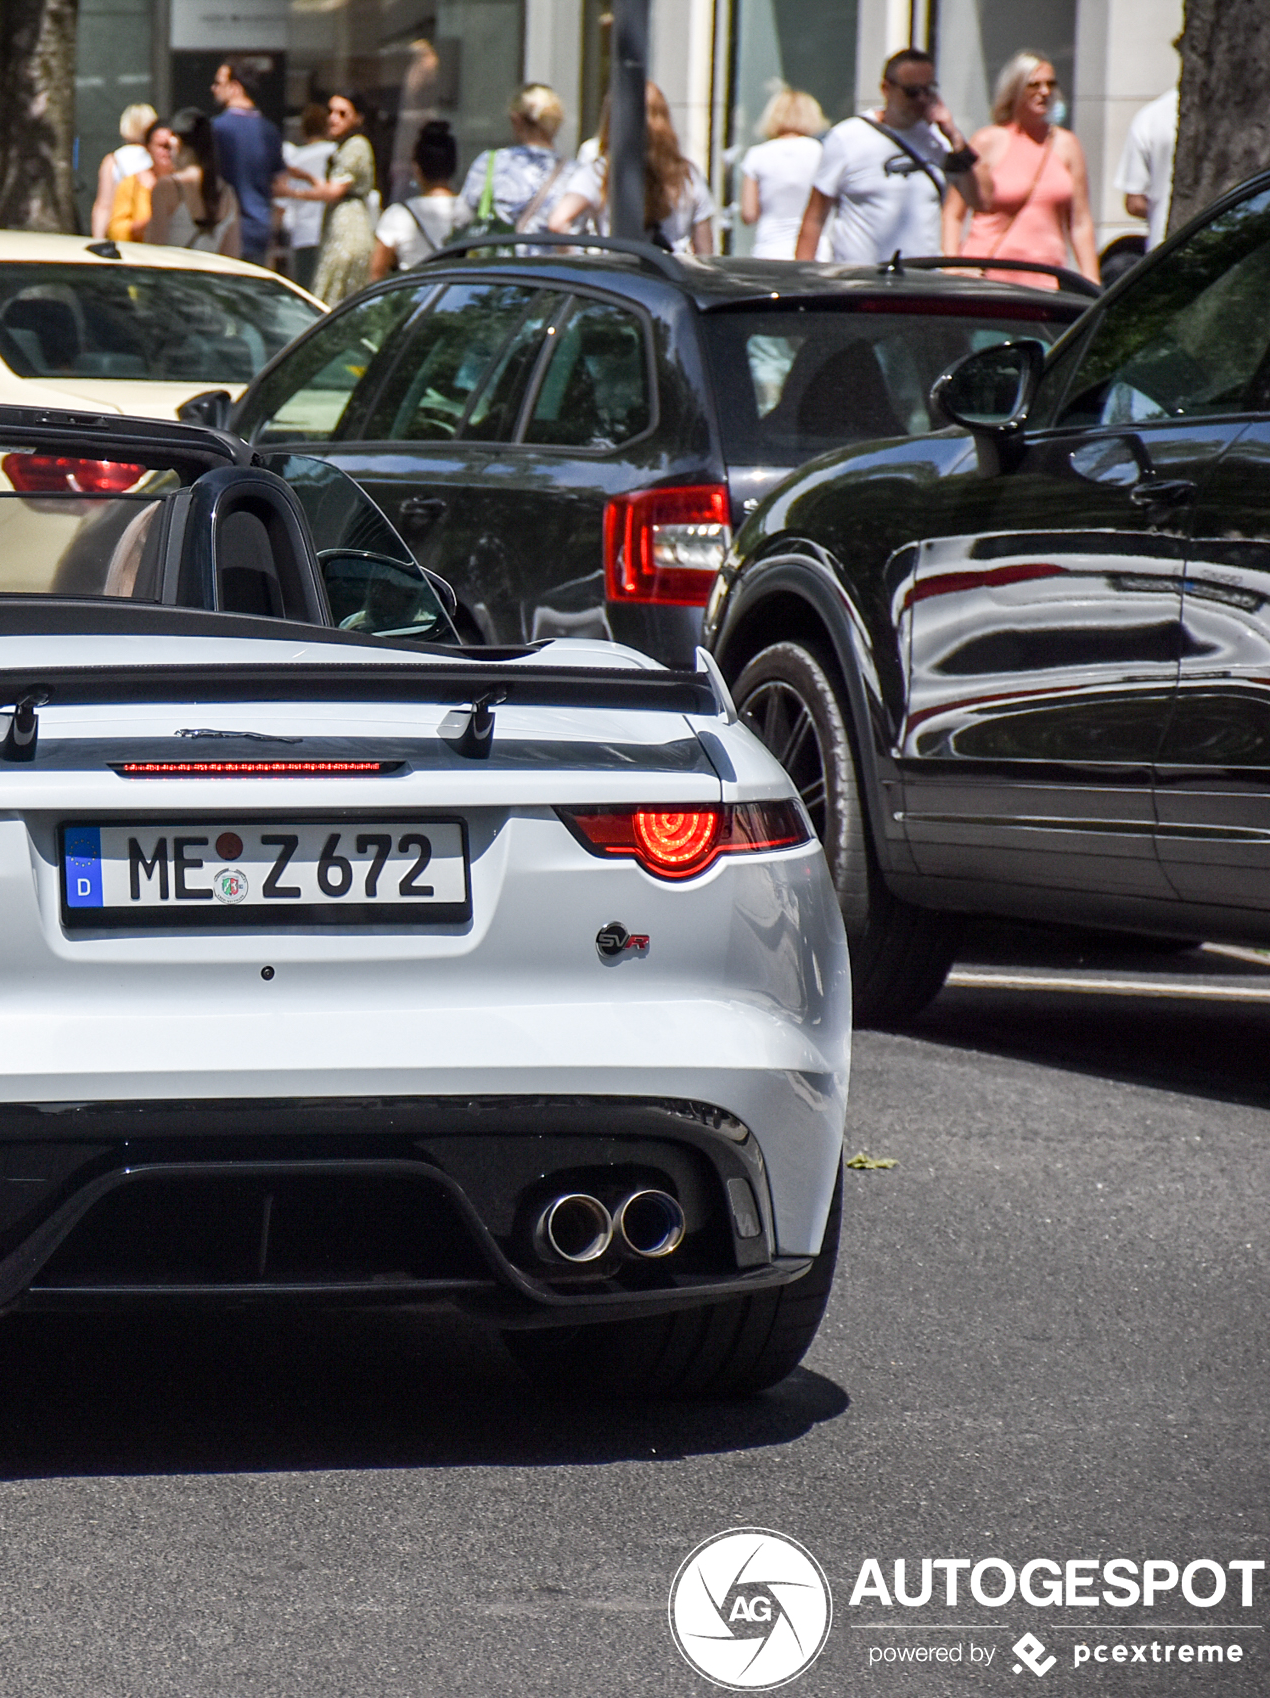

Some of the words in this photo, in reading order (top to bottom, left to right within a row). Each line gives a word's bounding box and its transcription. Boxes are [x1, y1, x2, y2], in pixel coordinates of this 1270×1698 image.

[129, 836, 213, 900] ME
[260, 834, 301, 898] Z
[317, 833, 434, 897] 672
[77, 878, 91, 896] D
[598, 933, 650, 950] SVR
